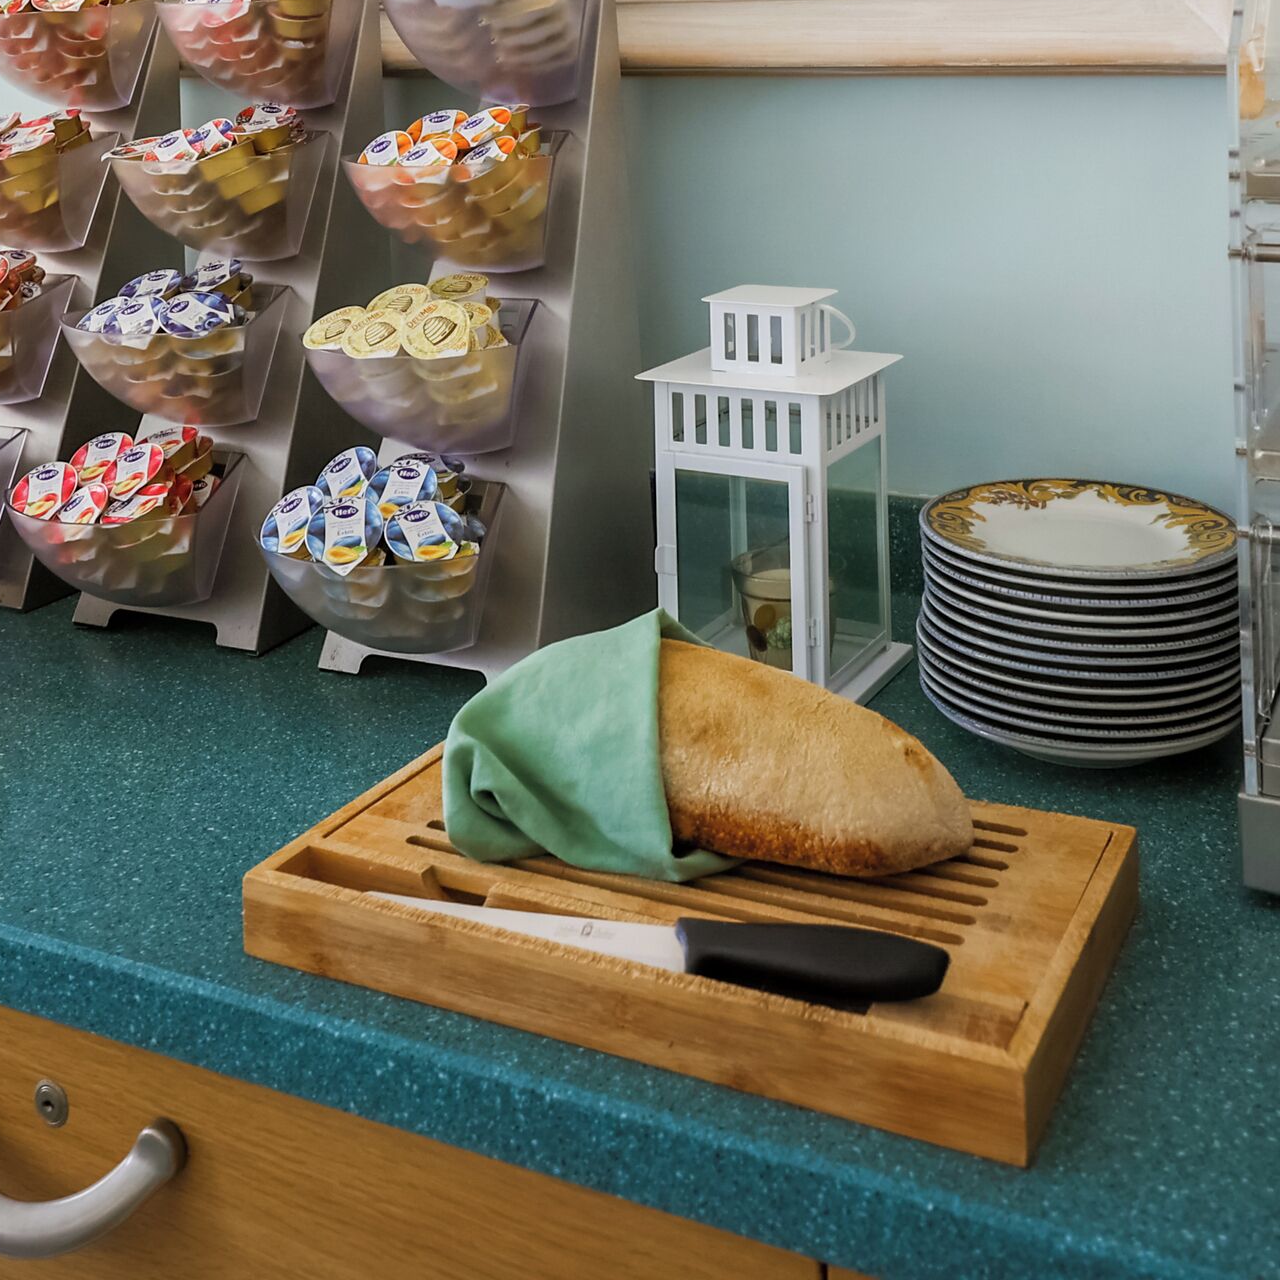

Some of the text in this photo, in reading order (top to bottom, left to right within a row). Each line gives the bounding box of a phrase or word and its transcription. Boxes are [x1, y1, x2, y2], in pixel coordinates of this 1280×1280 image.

[331, 459, 351, 473] Hero
[399, 469, 420, 478] Hero
[334, 506, 357, 517] Hero
[406, 511, 429, 522] Hero
